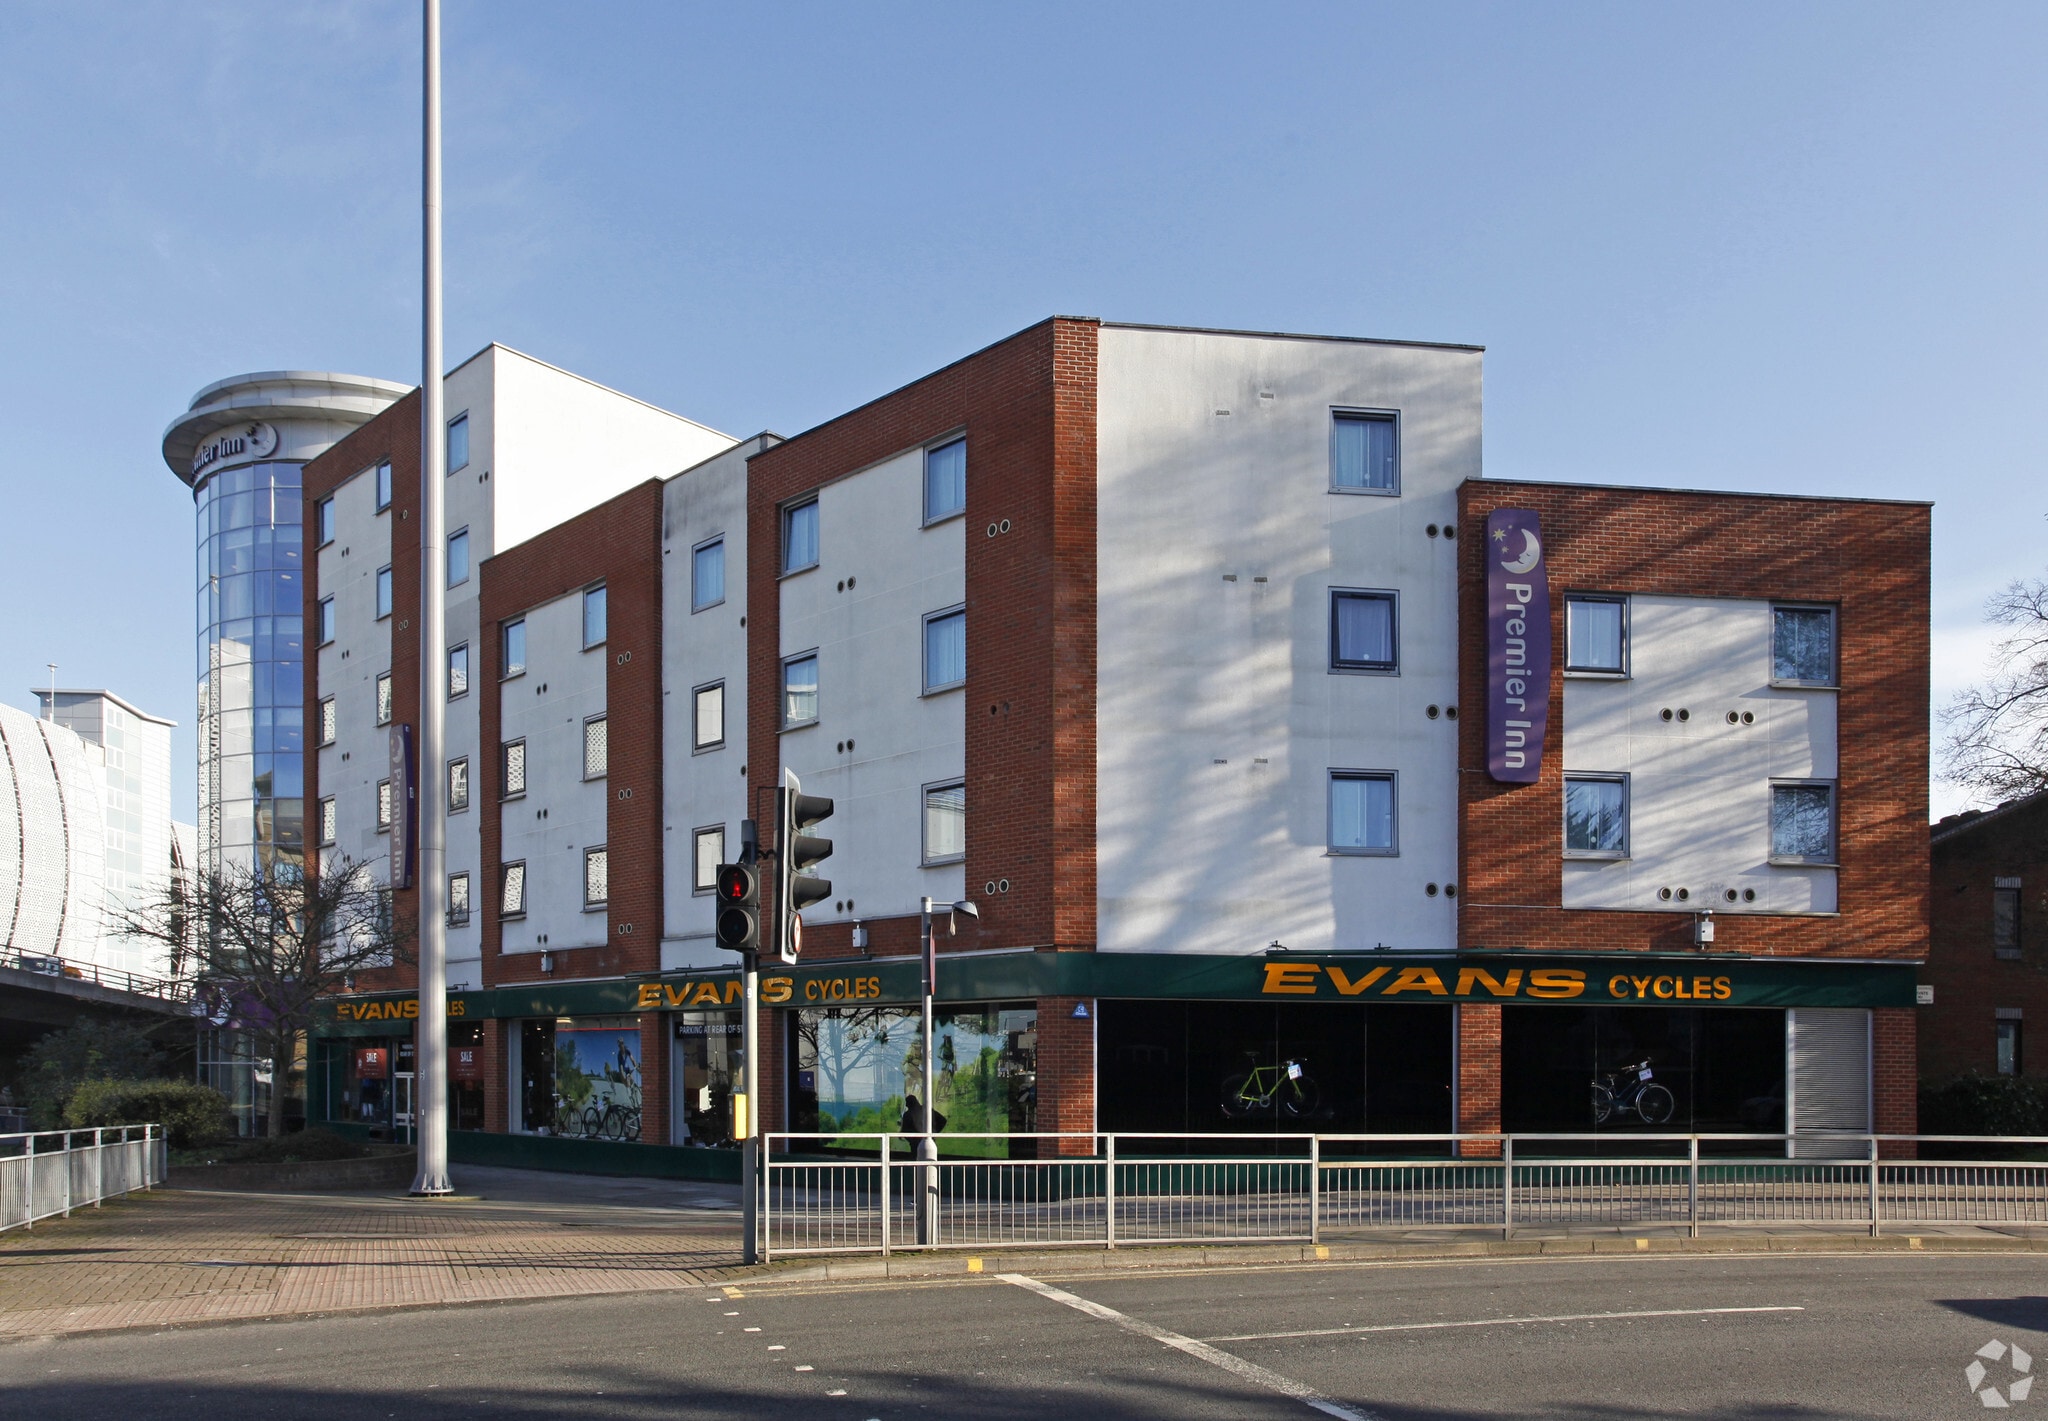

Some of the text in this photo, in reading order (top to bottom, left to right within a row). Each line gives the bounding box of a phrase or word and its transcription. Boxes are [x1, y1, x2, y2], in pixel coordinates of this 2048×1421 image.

[219, 437, 243, 457] Inn
[1505, 583, 1532, 769] Premier Inn
[393, 768, 403, 880] Premier Inn
[637, 976, 881, 1007] EVANS CYCLES
[1262, 963, 1732, 999] EVANS CYCLES
[447, 1000, 465, 1016] LES
[679, 1026, 702, 1034] PARKING
[704, 1025, 710, 1034] AT
[711, 1024, 727, 1034] REAR
[728, 1024, 736, 1033] OF
[460, 1051, 473, 1062] SALE
